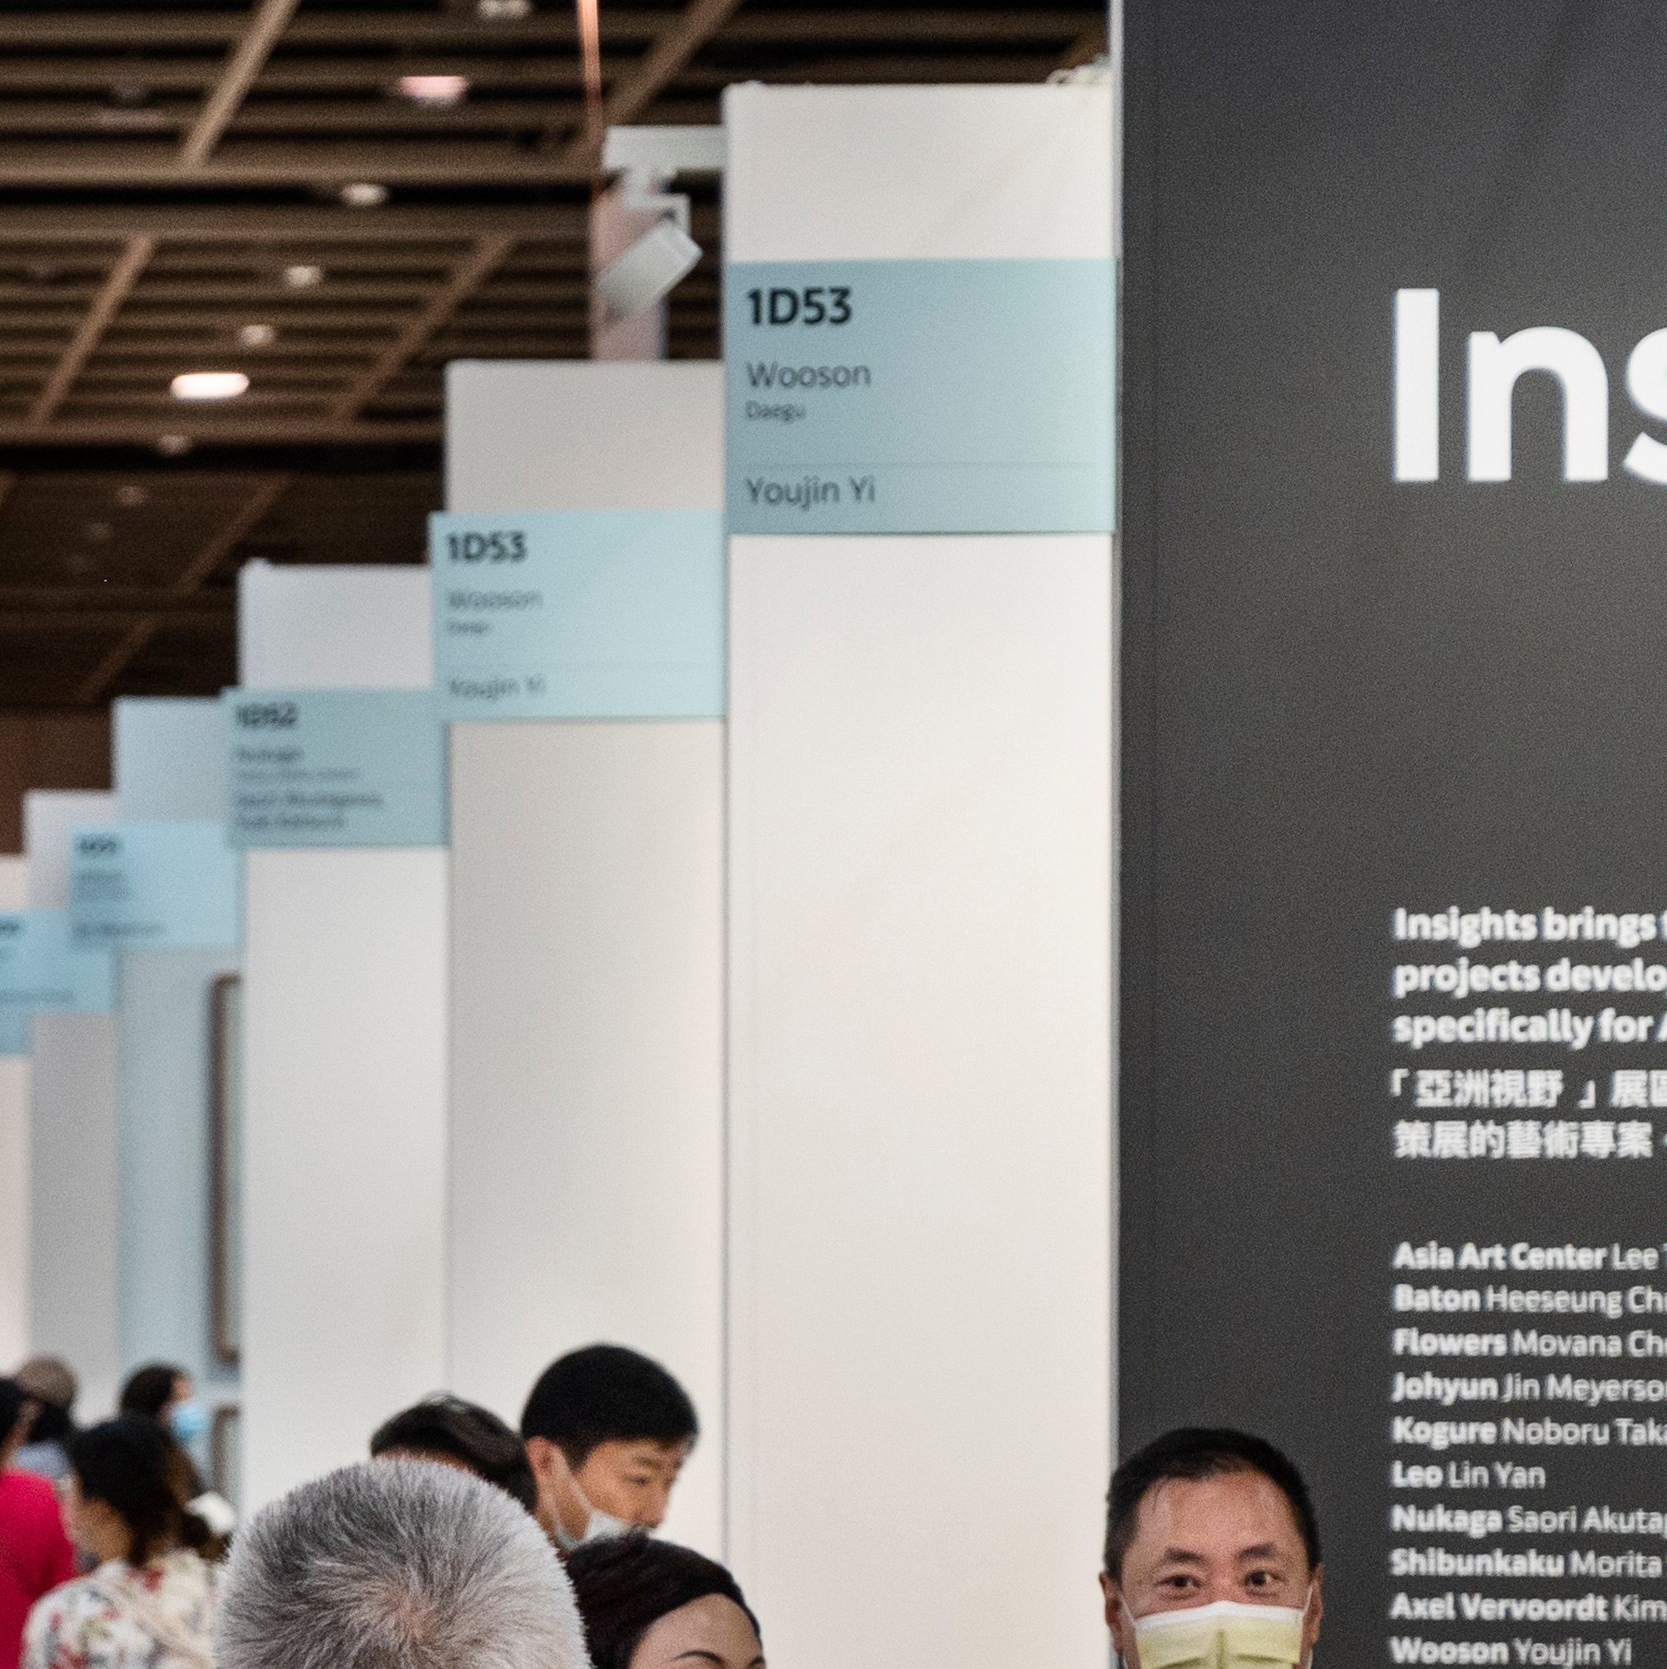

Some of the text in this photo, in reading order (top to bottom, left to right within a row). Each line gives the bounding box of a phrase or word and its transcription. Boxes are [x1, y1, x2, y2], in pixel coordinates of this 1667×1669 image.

[747, 286, 852, 326] 1D53
[745, 361, 871, 388] Wooson
[745, 475, 876, 511] Youjin Yi
[446, 530, 526, 565] 1D53
[1394, 906, 1538, 948] Insights
[1542, 906, 1657, 948] brings
[1394, 957, 1541, 998] projects
[1393, 1008, 1594, 1050] specifically
[1598, 1008, 1654, 1042] for
[1393, 1241, 1658, 1270] Asia Art Center Lee
[1394, 1284, 1667, 1319] Baton Heeseung Ch
[1393, 1328, 1667, 1357] Flowers Movana Ch
[1392, 1372, 1667, 1406] Johyun Jin Meyerso
[1392, 1417, 1497, 1450] Kogure
[1501, 1417, 1609, 1445] Noboru
[1392, 1461, 1546, 1488] Leo Lin Yan
[1391, 1504, 1502, 1538] Nukaga
[1507, 1505, 1577, 1533] Saori
[1390, 1548, 1662, 1578] Shibunkaku Morita
[1390, 1593, 1667, 1621] Axel Vervoordt Kim
[1390, 1637, 1631, 1669] Wooson Youjin Yi
